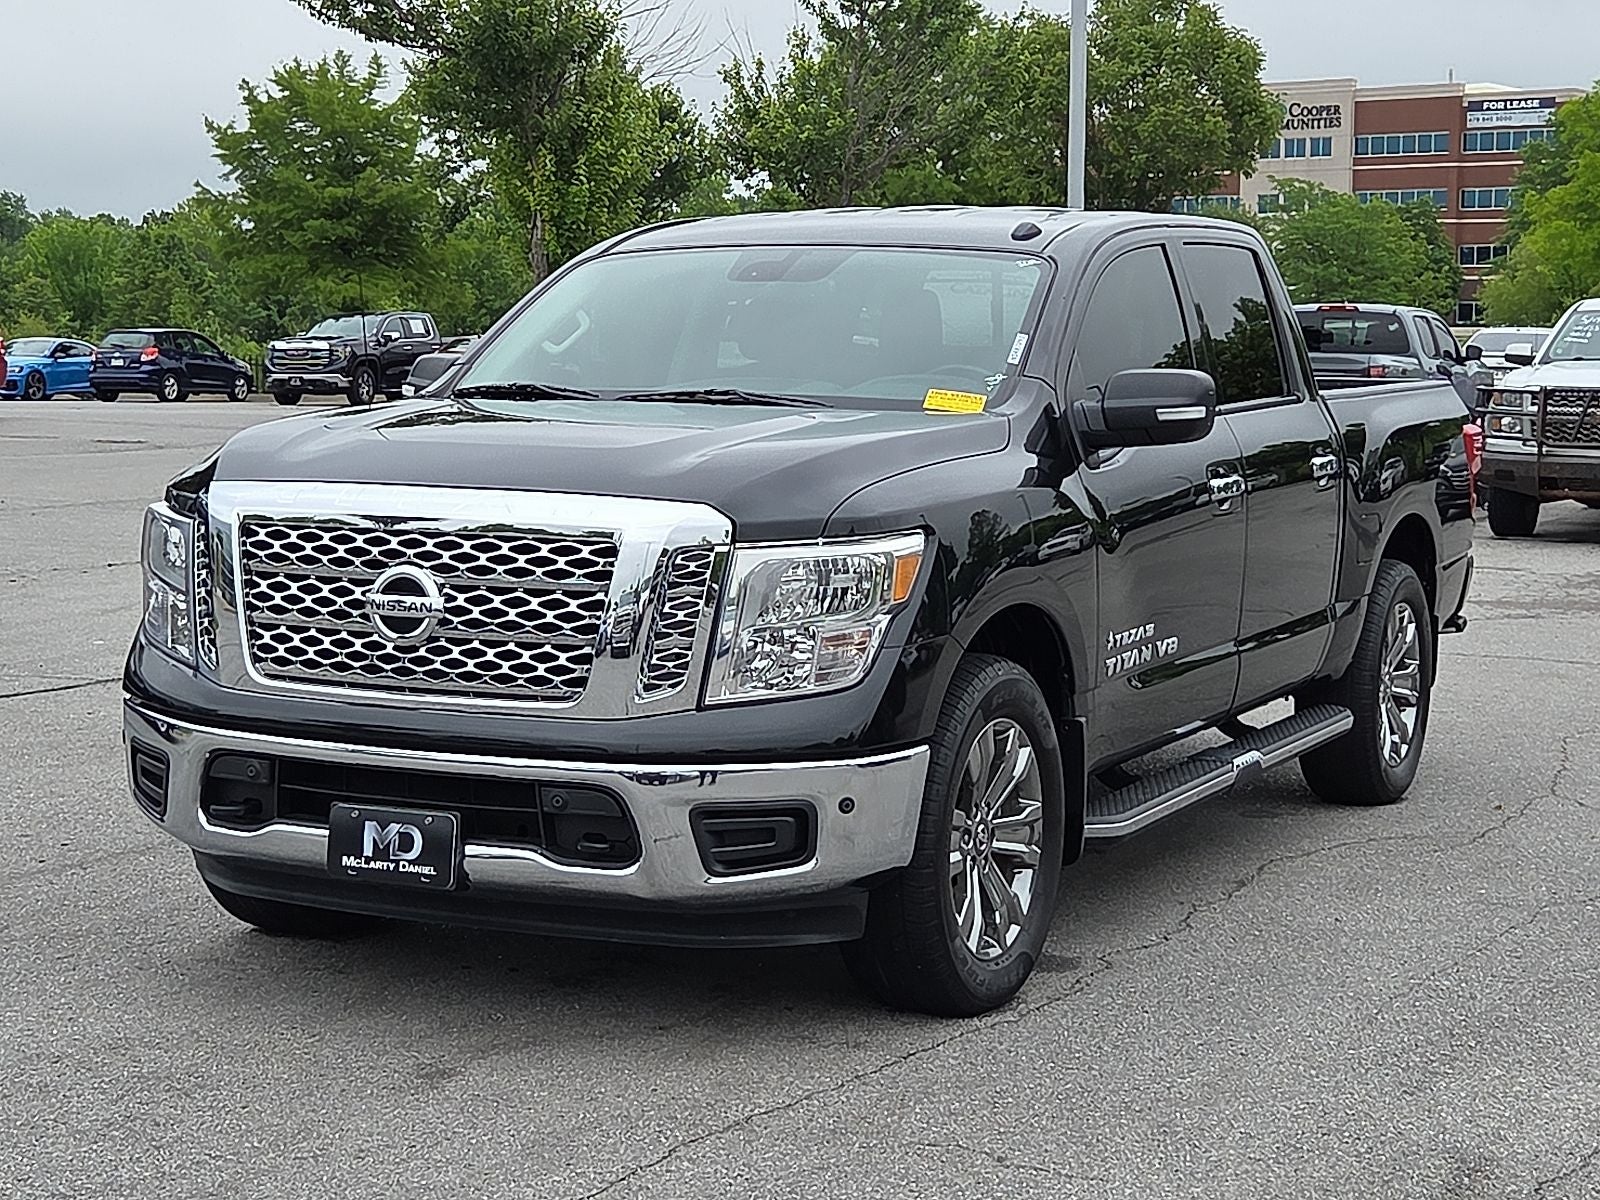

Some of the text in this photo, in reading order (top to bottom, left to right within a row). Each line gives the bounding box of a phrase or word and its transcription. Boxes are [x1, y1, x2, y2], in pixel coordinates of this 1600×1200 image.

[1289, 103, 1341, 117] COOPER
[1482, 99, 1540, 110] FOR LEASE
[371, 598, 432, 613] NISSAN
[1105, 636, 1178, 677] TITAN V8
[363, 821, 423, 860] MD
